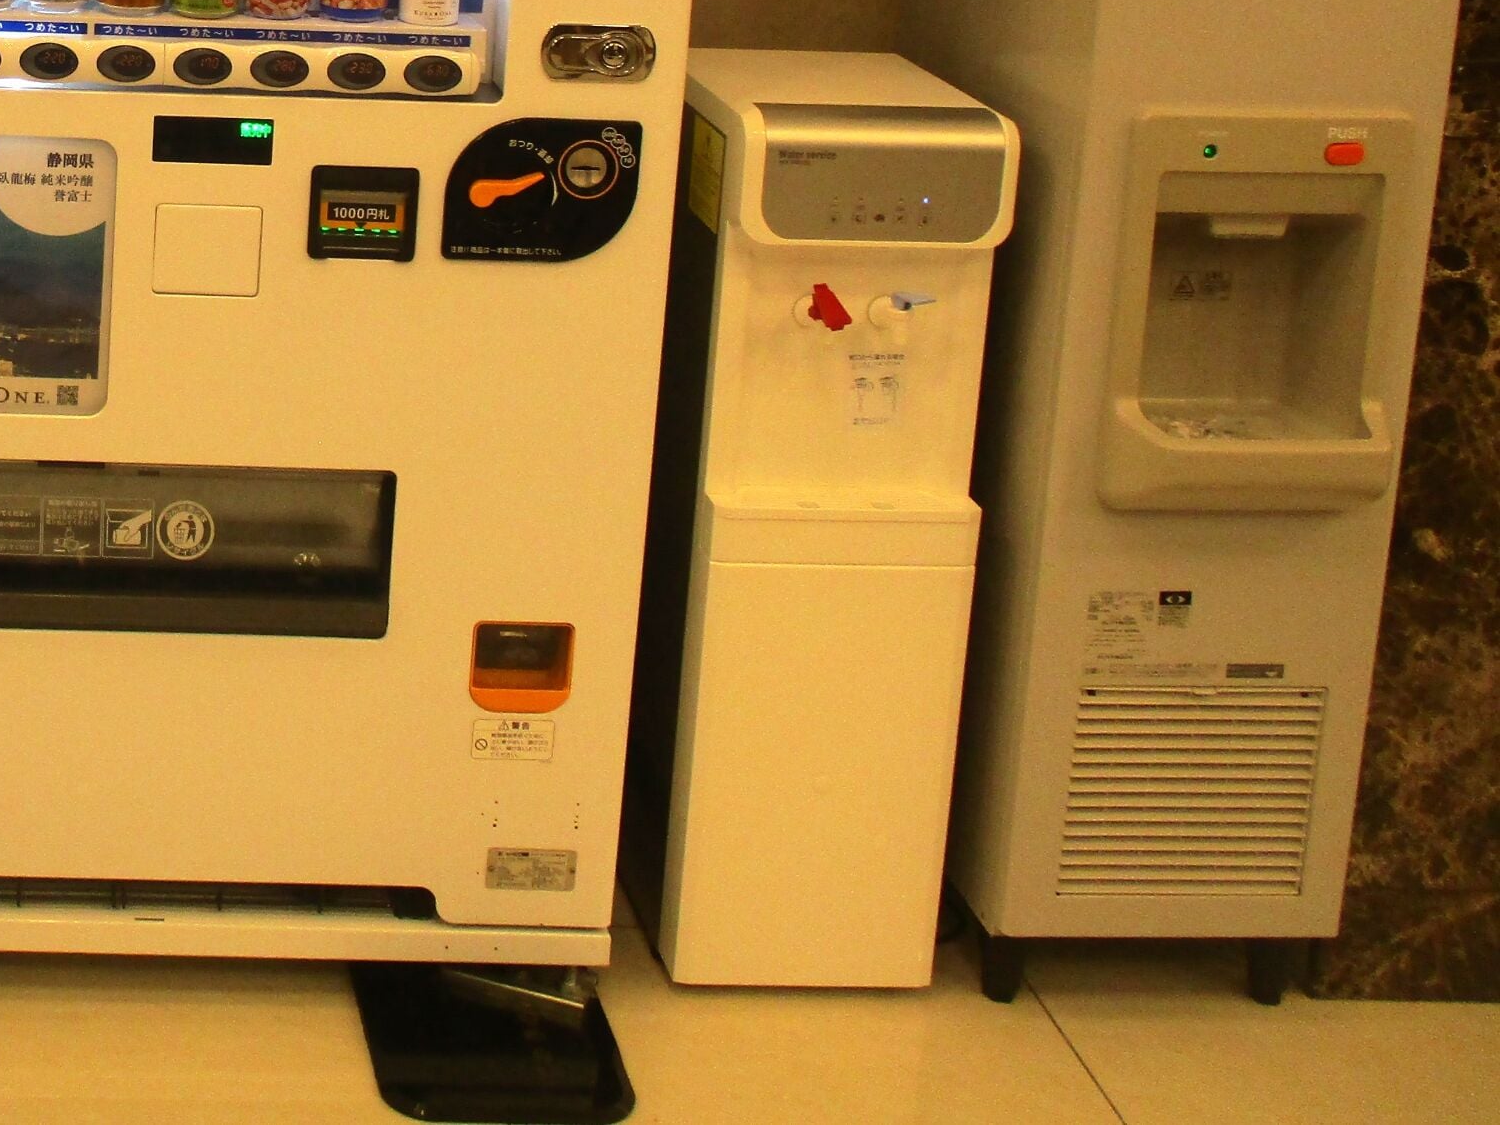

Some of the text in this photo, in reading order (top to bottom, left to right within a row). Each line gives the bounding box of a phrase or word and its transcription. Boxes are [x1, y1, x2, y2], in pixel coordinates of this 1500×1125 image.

[1327, 127, 1368, 139] PUSH
[46, 152, 94, 169] 静岡県
[41, 173, 94, 188] 純米吟醸
[53, 189, 93, 203] 誉富士
[332, 206, 391, 221] 1000円札
